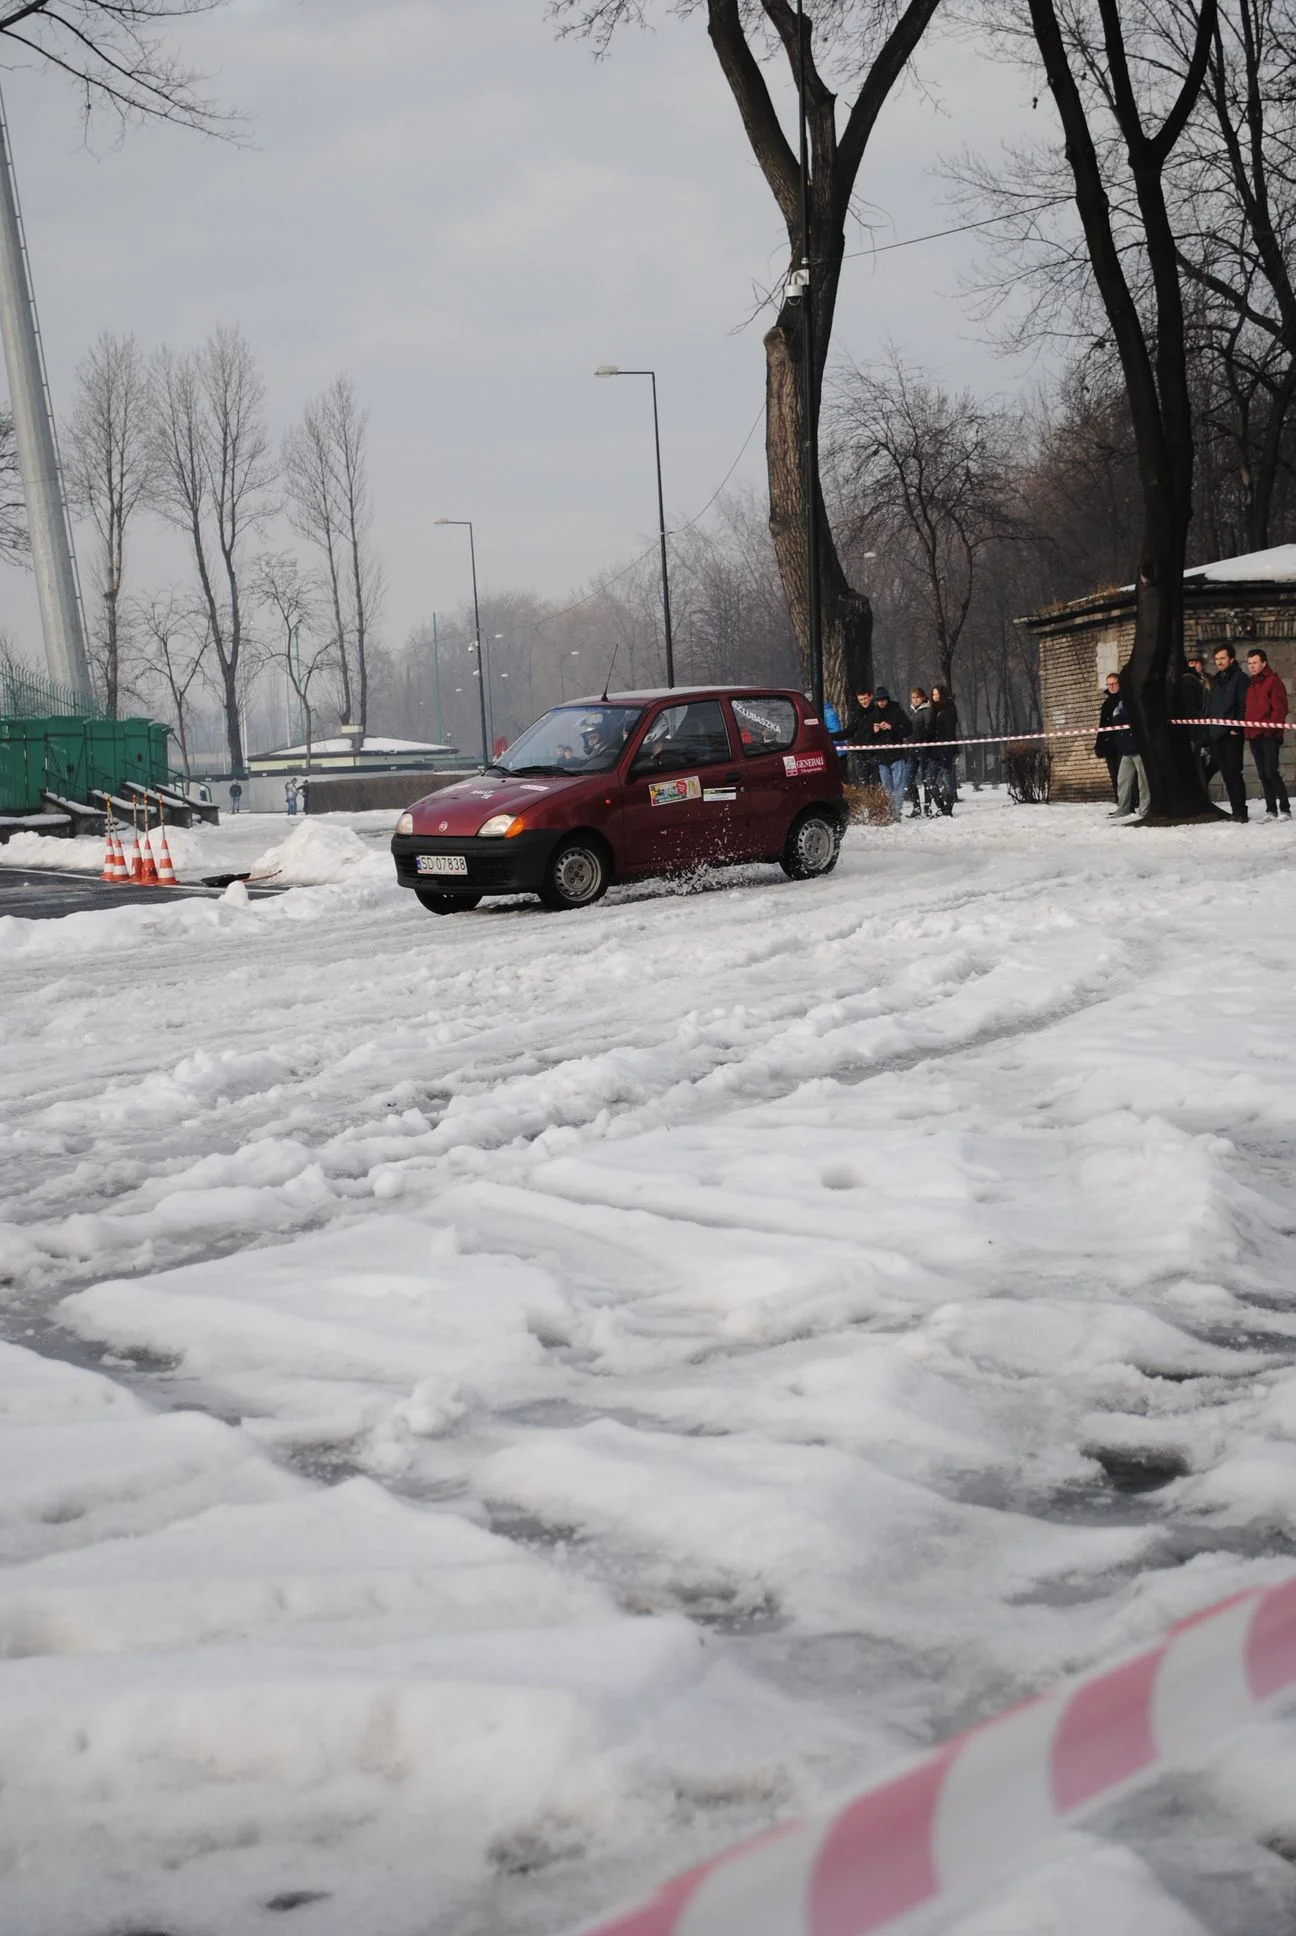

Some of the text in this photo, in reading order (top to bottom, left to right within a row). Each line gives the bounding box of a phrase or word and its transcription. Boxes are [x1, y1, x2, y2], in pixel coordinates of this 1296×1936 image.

[796, 757, 824, 769] GENERALI
[420, 857, 466, 871] SD 07838
